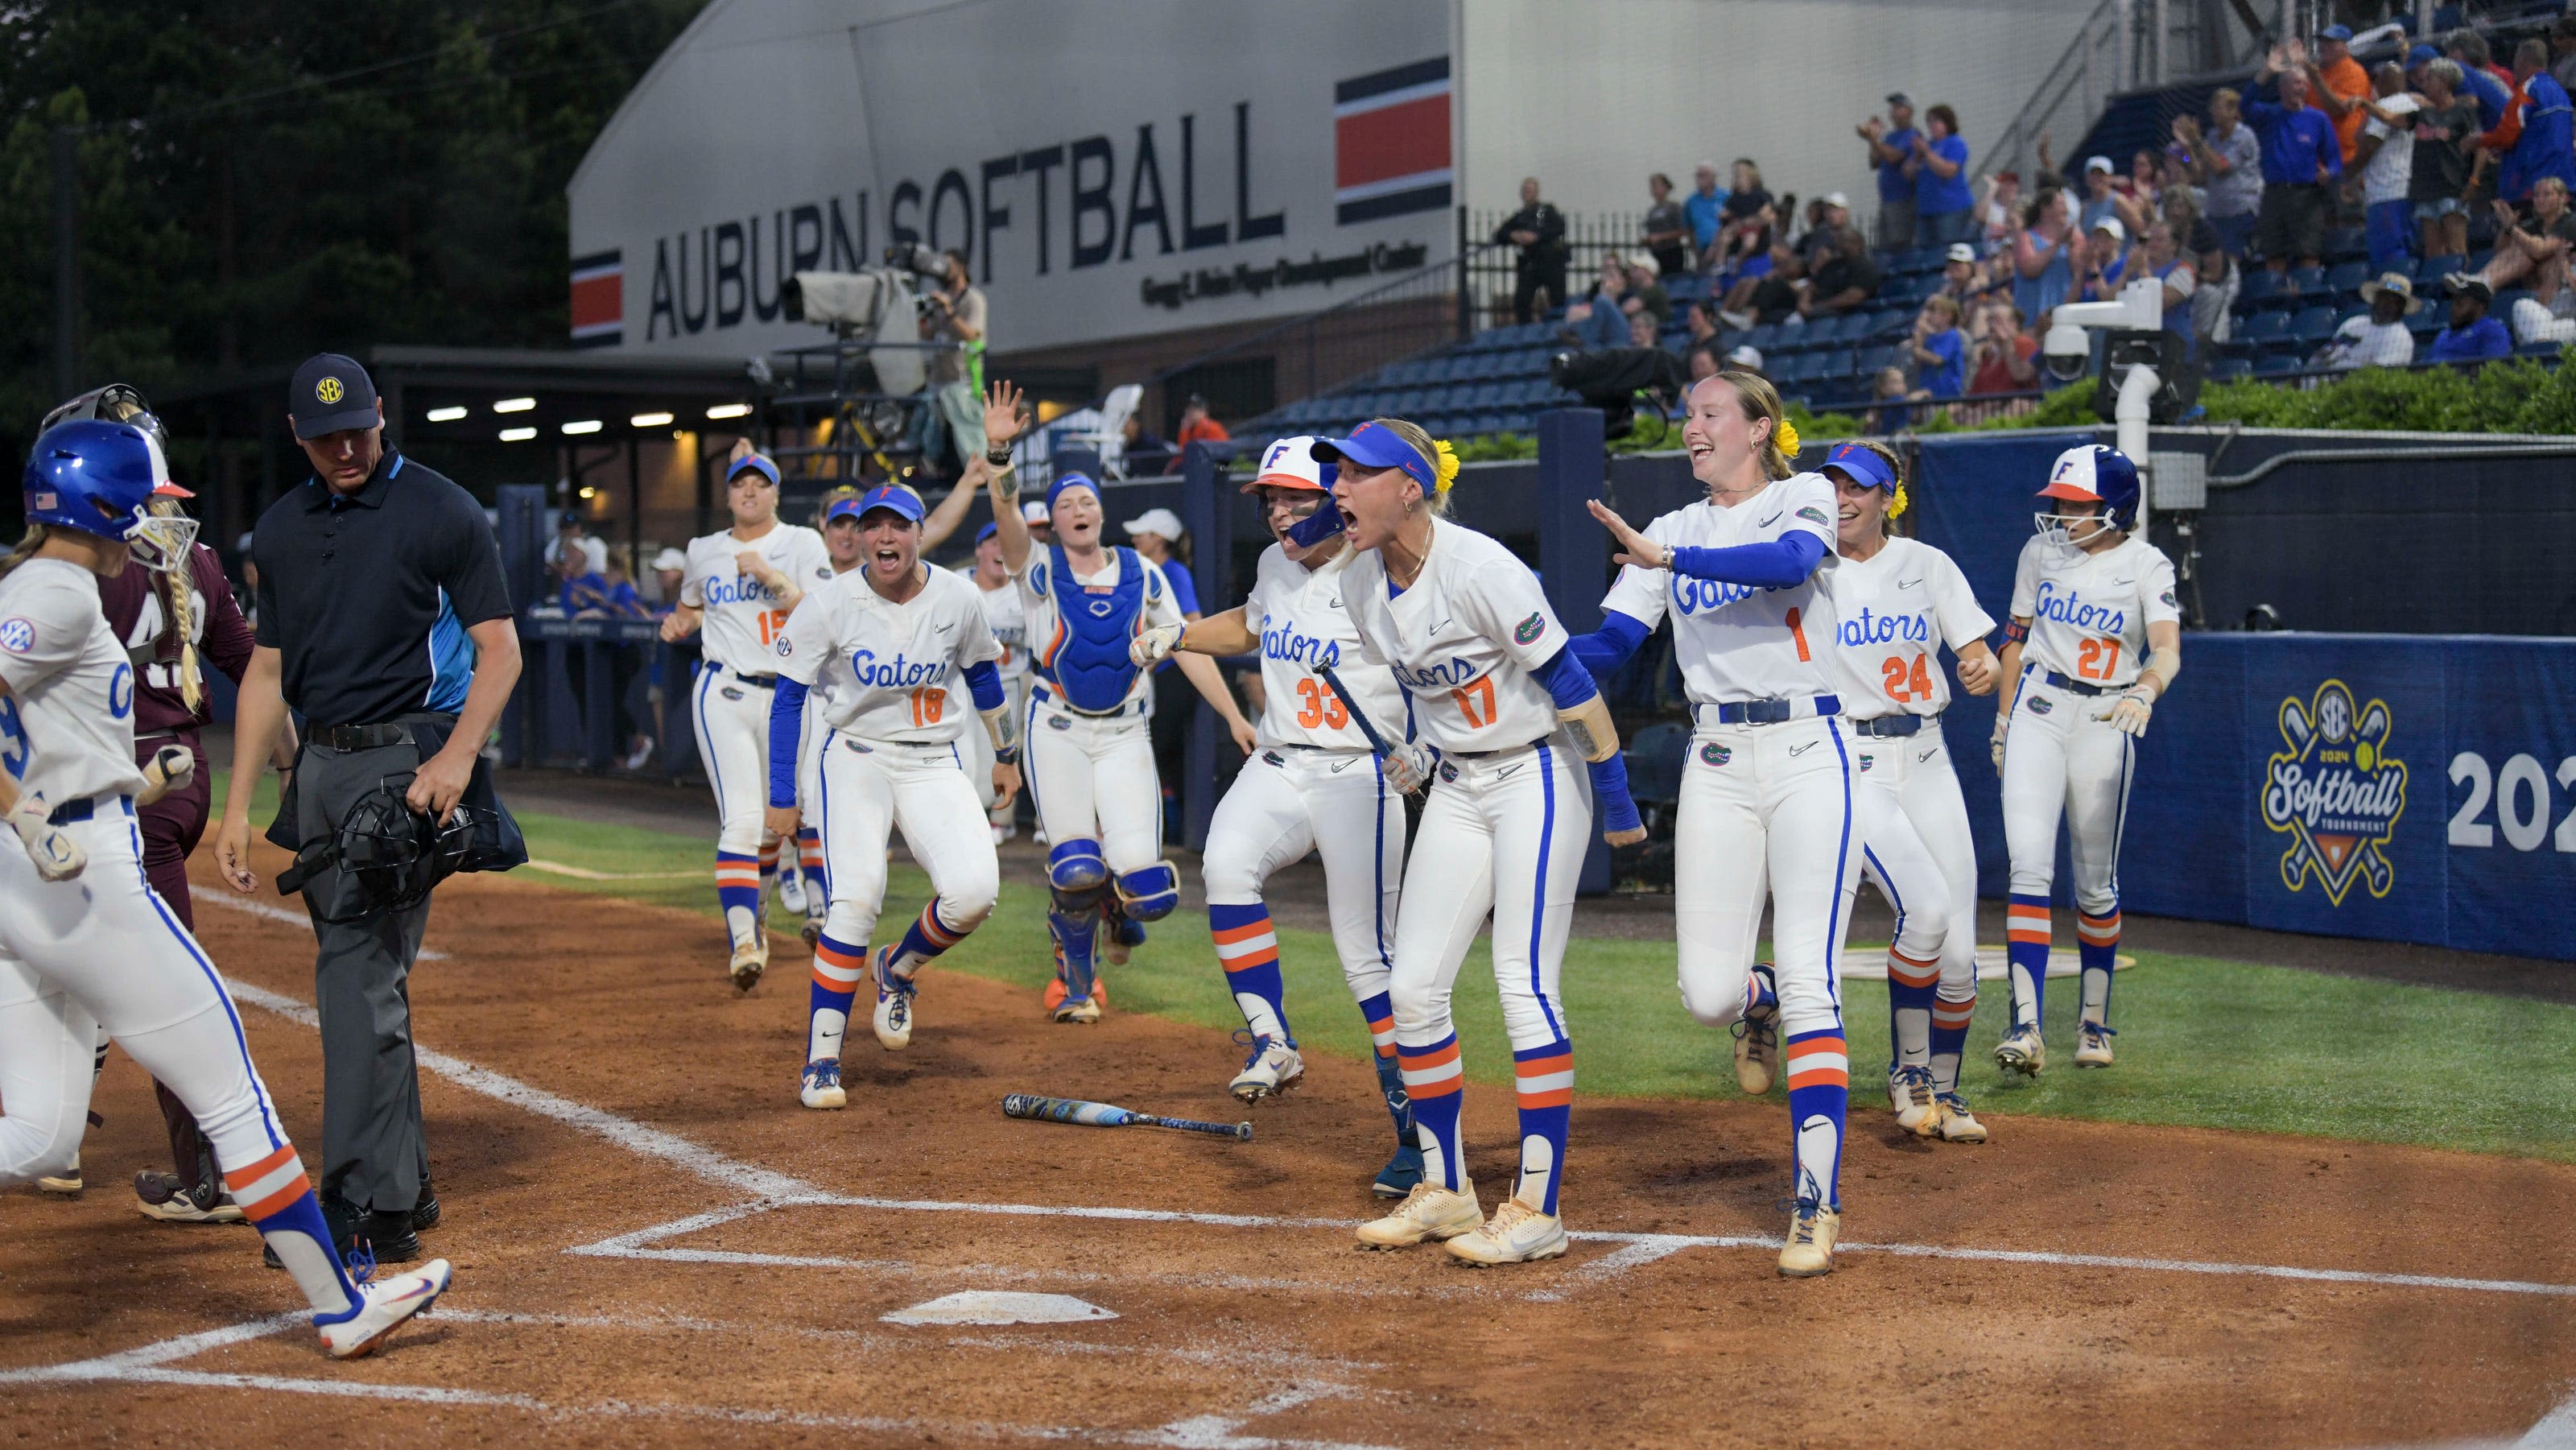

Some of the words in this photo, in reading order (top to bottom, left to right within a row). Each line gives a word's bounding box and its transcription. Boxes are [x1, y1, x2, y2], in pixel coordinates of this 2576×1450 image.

[647, 189, 868, 342] AUBURN
[890, 101, 1284, 283] SOFTBALL
[318, 378, 341, 402] SEC
[1265, 445, 1290, 469] F
[1838, 445, 1855, 459] F
[2054, 461, 2074, 481] F
[1836, 606, 1929, 647] ators
[2036, 581, 2124, 634] Gators
[0, 619, 33, 651] SEC
[1785, 606, 1810, 662] 1
[852, 649, 946, 687] Gators
[1882, 653, 1932, 704] 24
[2078, 638, 2121, 680] 27
[910, 687, 947, 728] 18
[1297, 678, 1348, 730] 33
[1451, 673, 1496, 729] 17
[2321, 695, 2348, 740] SEC
[2319, 750, 2350, 763] 2024
[2268, 762, 2401, 828] Softball
[2322, 817, 2385, 832] TOURNAMENT
